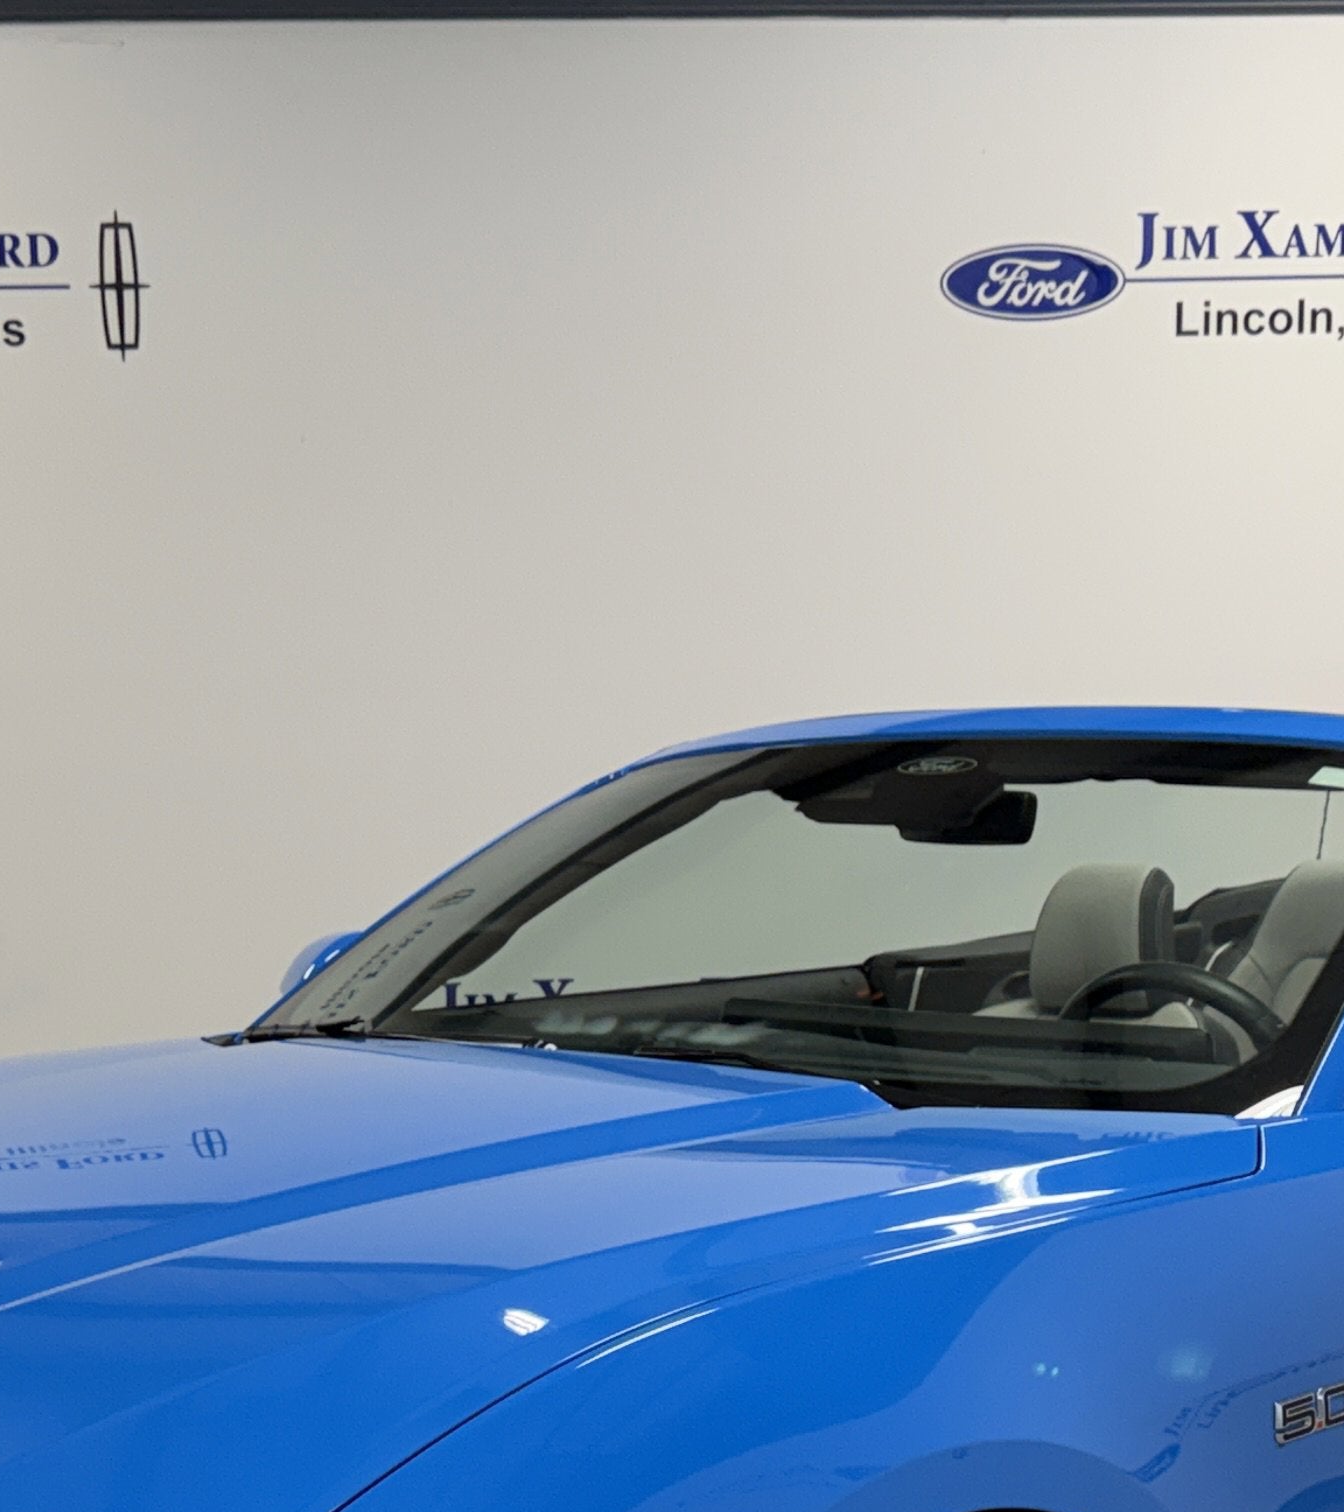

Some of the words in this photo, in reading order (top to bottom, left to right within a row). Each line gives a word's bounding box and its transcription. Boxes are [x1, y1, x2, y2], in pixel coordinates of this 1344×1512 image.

[1135, 212, 1218, 270] JIM
[976, 257, 1089, 310] Ford
[1175, 298, 1344, 340] Lincoln,
